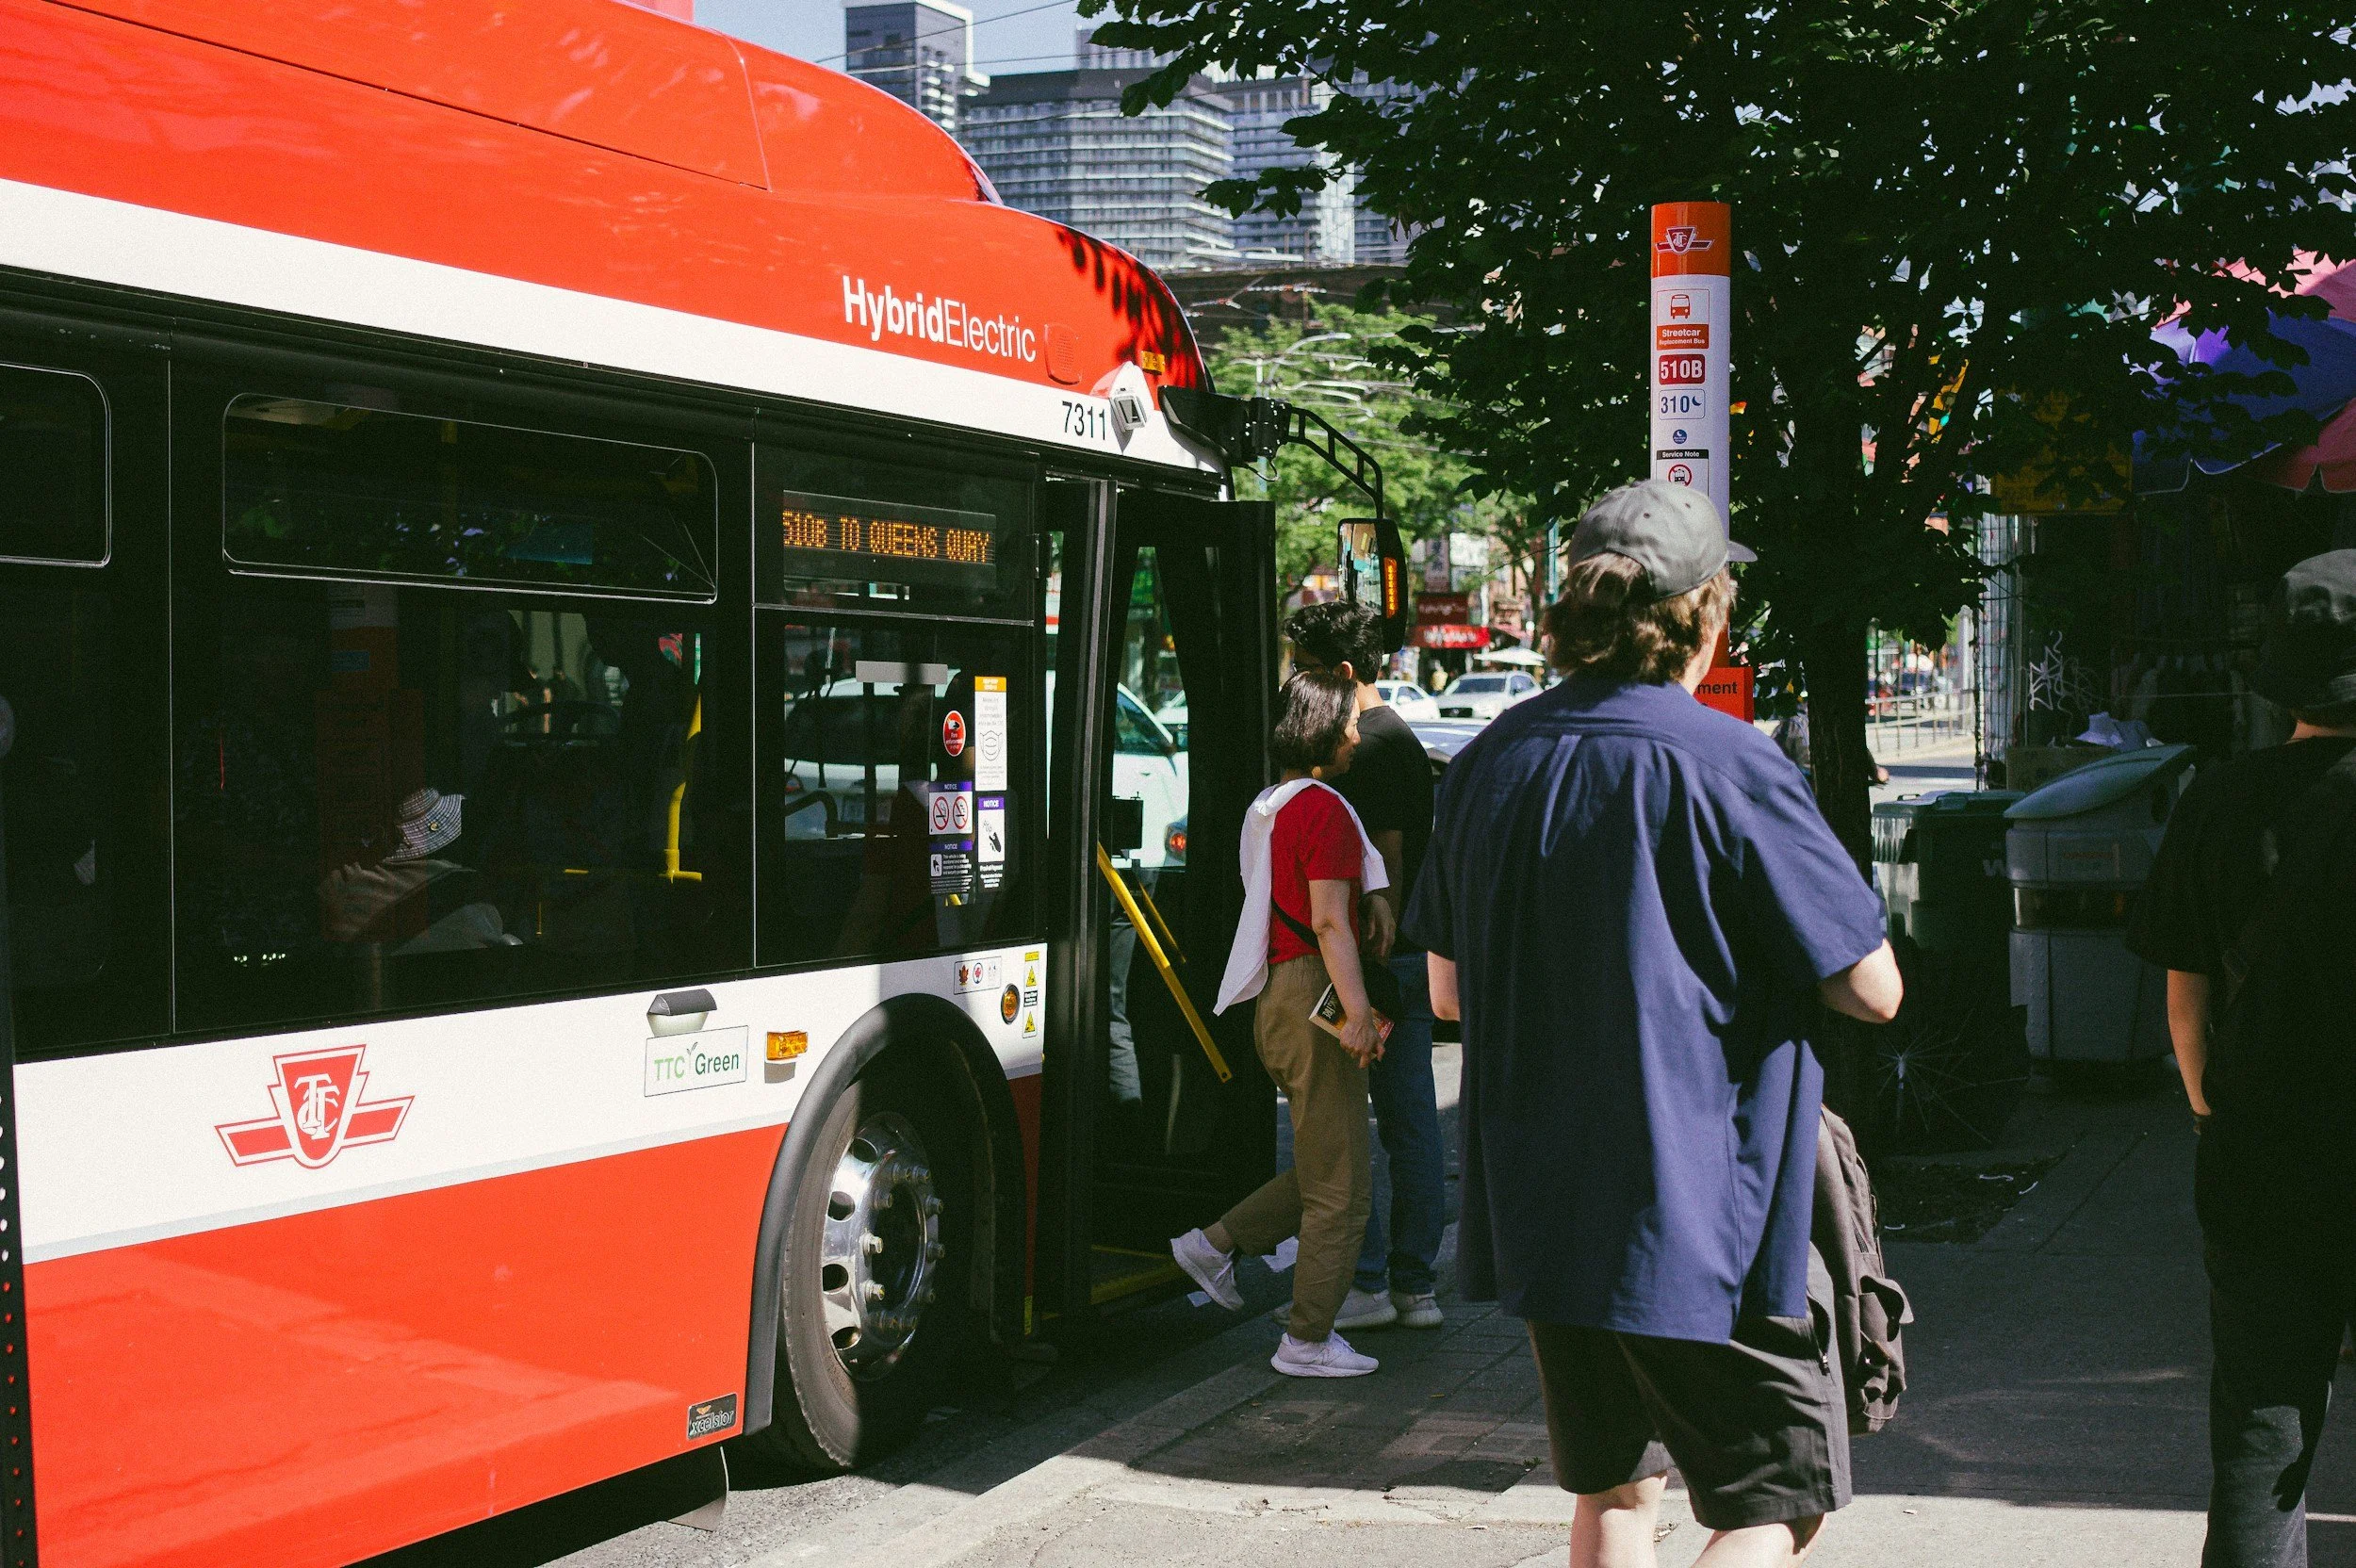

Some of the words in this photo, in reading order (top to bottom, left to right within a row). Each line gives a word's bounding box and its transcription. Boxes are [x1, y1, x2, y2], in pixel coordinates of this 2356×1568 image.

[1661, 329, 1701, 337] Streetcar
[1660, 359, 1703, 380] 510B
[1661, 395, 1689, 414] 310
[1062, 400, 1106, 441] 7311
[840, 515, 859, 551] TO
[869, 520, 938, 558] QUEENS
[946, 528, 990, 564] QUAY
[983, 799, 1000, 808] NOTICE
[653, 1052, 686, 1082] TTC
[695, 1051, 741, 1078] Green
